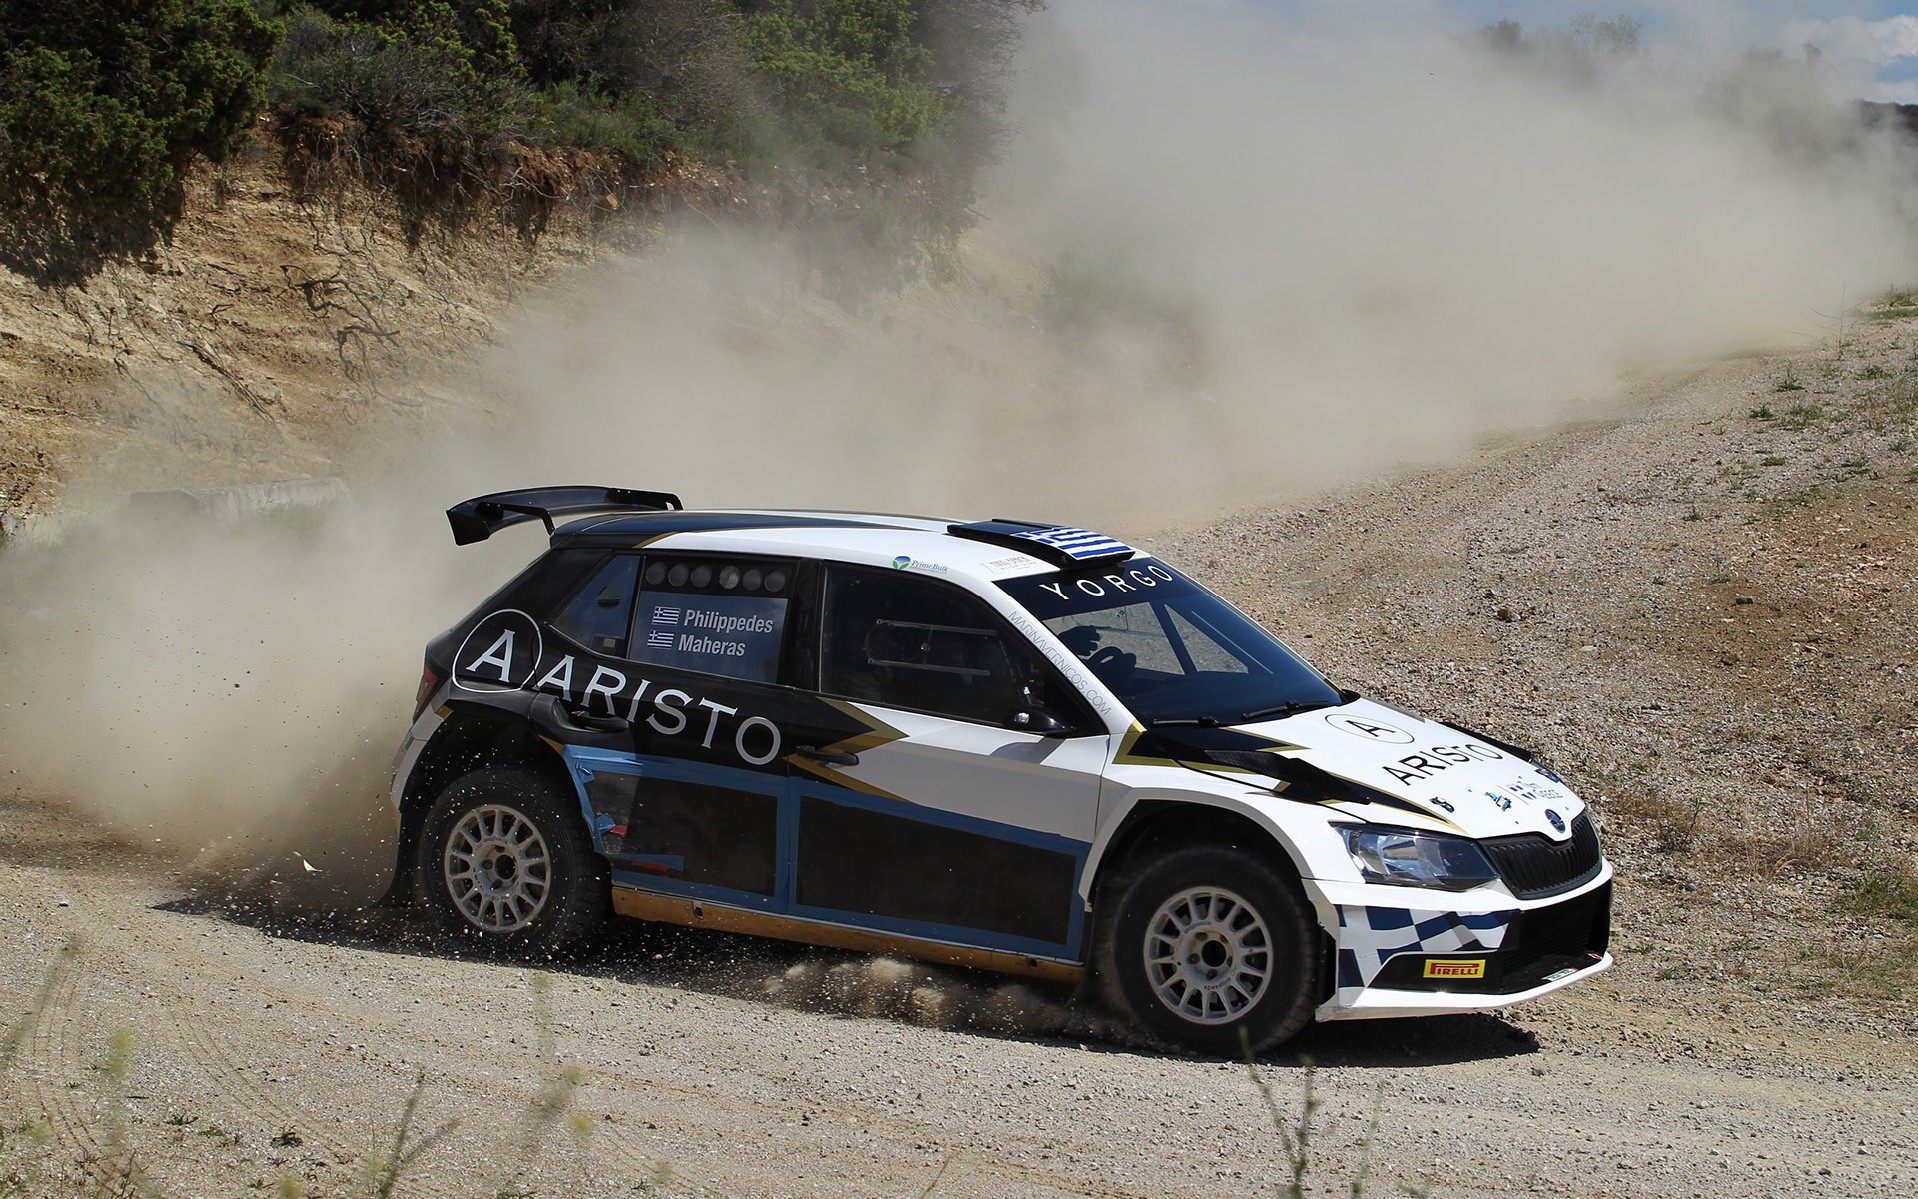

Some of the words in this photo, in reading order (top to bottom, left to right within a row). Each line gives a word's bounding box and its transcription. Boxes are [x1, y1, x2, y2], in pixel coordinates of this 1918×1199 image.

[911, 559, 949, 572] PrimeBulk
[1039, 565, 1173, 600] YORGO
[683, 609, 774, 633] Philippedes
[465, 628, 516, 683] A
[678, 634, 746, 657] Maheras
[1008, 611, 1112, 716] MARINAVERNICOS.COM
[531, 654, 781, 765] ARISTO
[1344, 719, 1396, 738] A
[1381, 743, 1503, 786] ARISTO
[1429, 962, 1480, 975] PIRELLI
